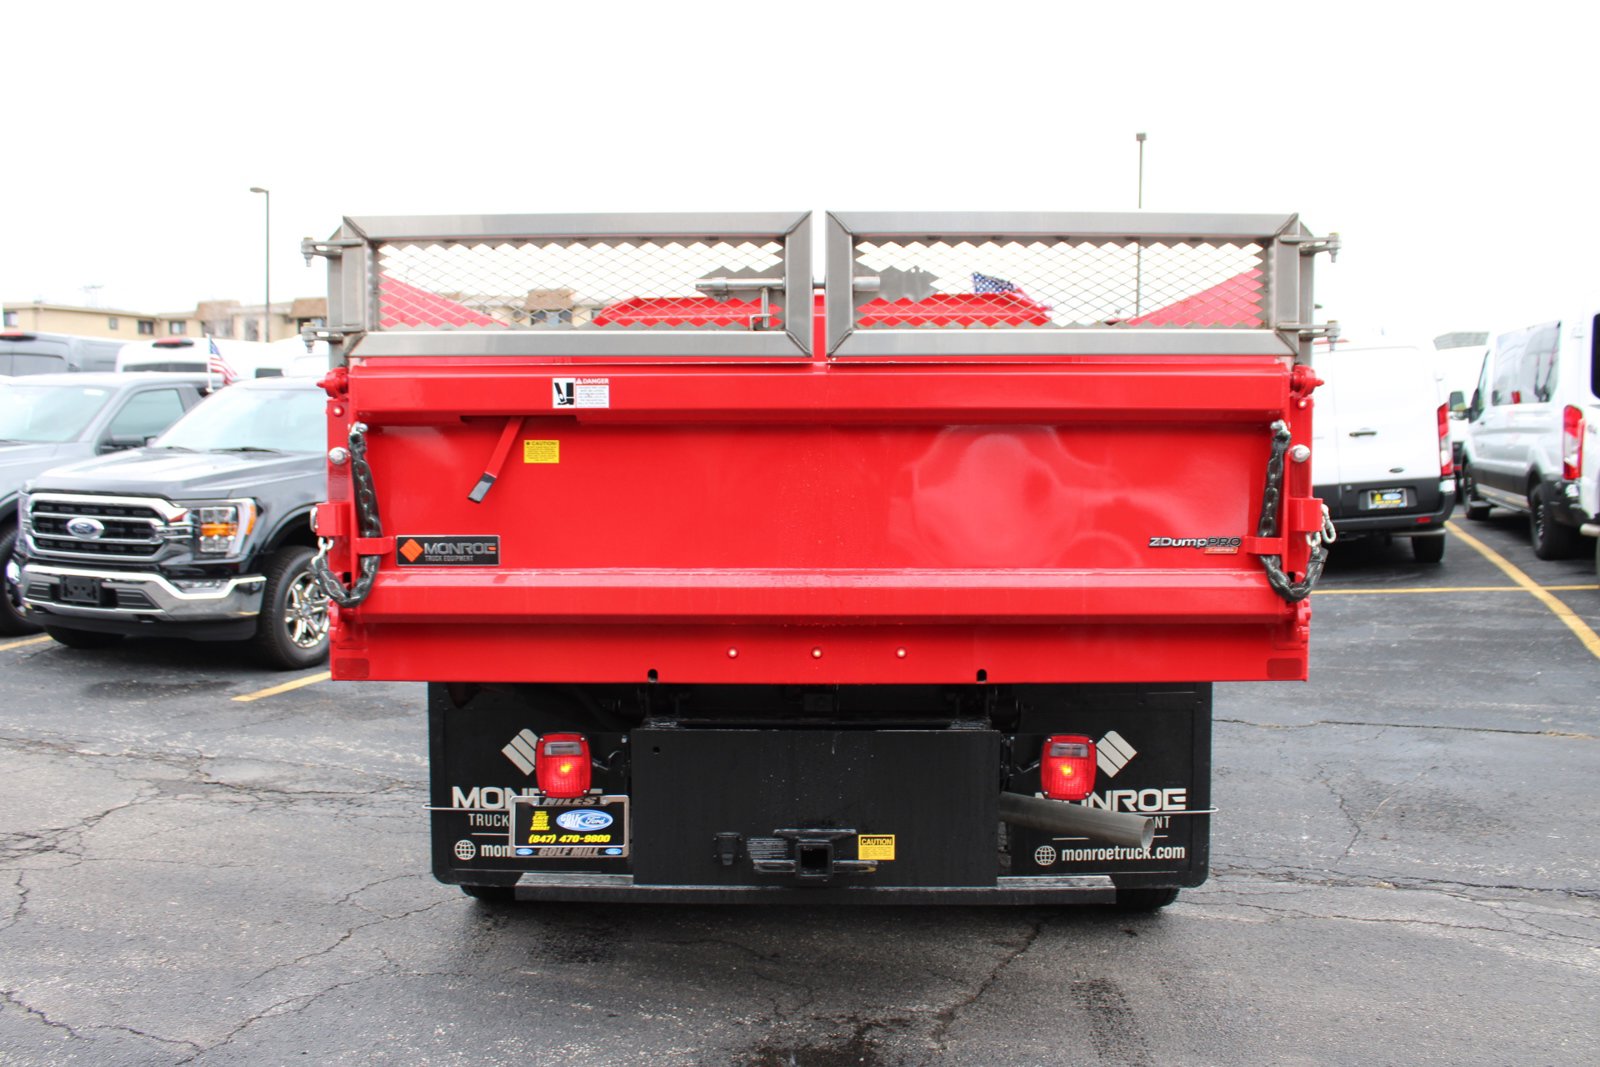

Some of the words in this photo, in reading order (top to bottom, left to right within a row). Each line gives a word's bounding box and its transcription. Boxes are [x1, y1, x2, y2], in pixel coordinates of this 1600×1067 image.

[424, 542, 497, 555] MONROE
[468, 813, 510, 827] TRUCK
[585, 816, 607, 825] Ford
[528, 834, 557, 844] (847)
[538, 847, 570, 856] GOLF
[570, 847, 599, 856] MILL
[1061, 845, 1185, 862] monroetruck.com
